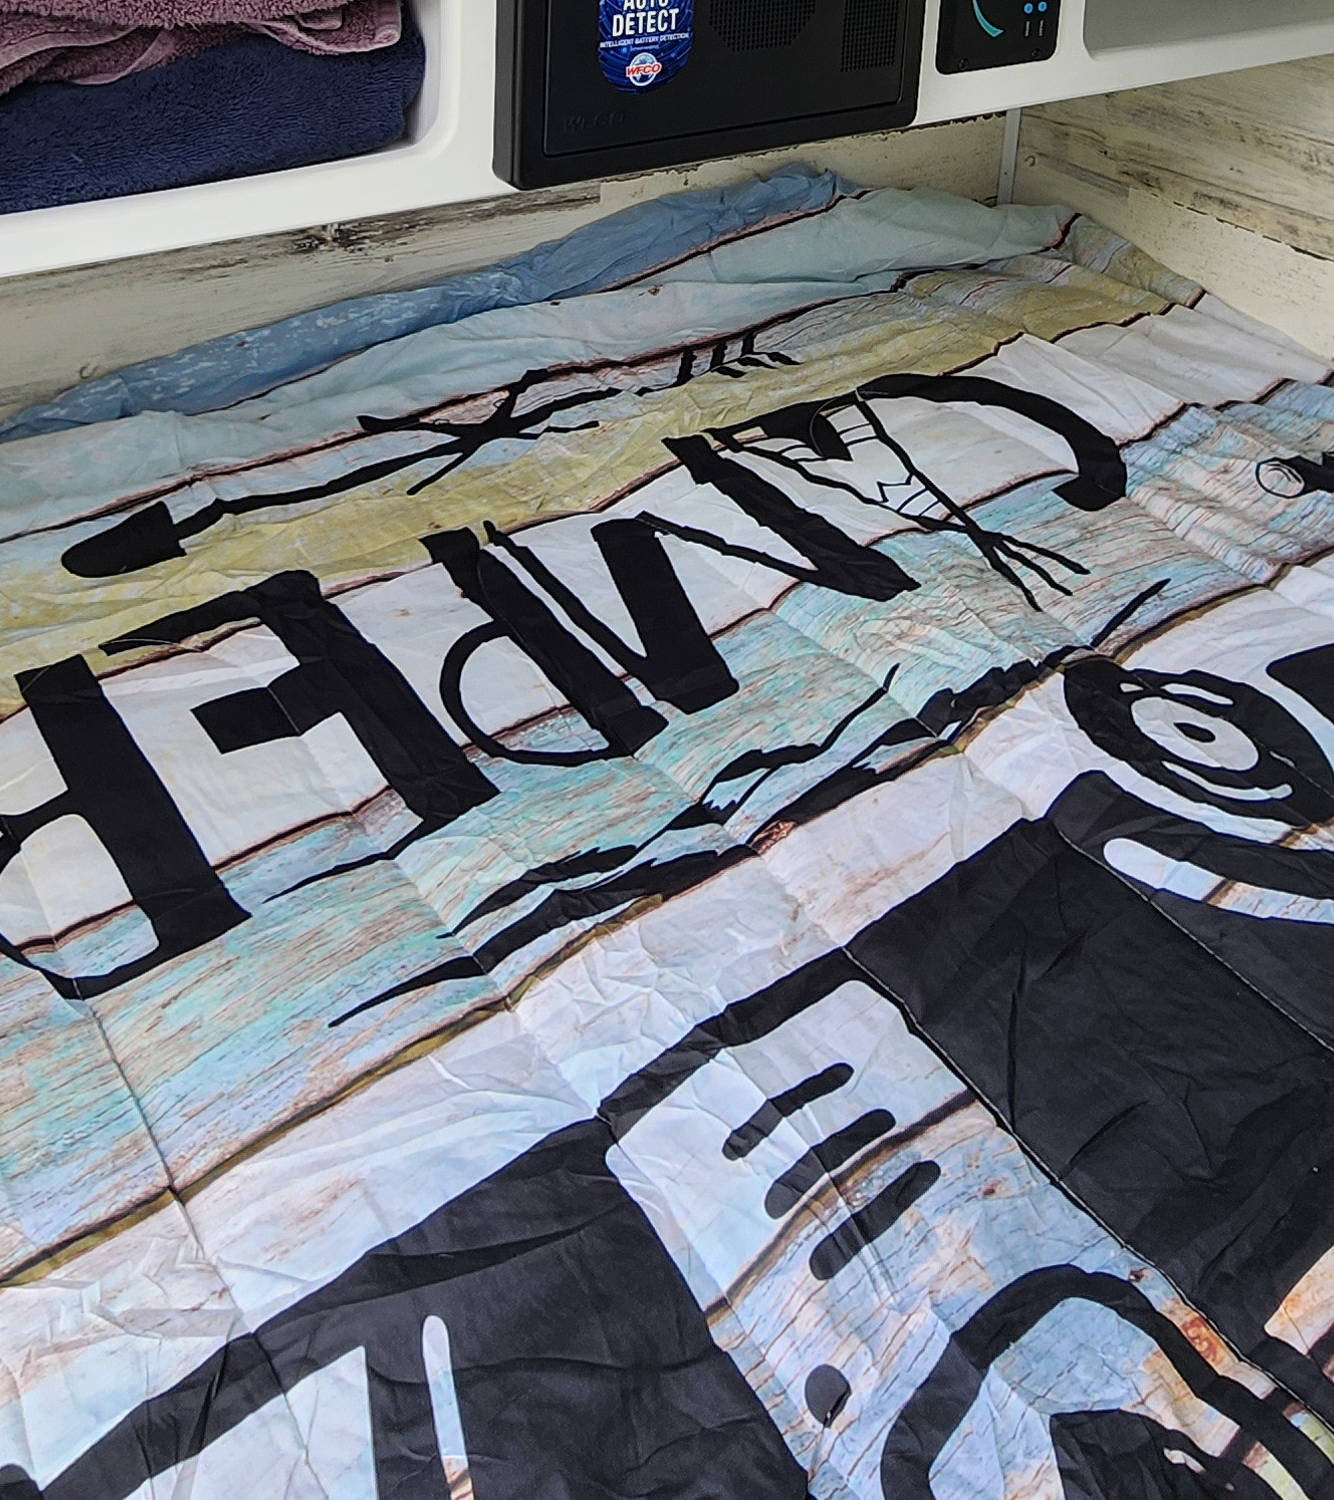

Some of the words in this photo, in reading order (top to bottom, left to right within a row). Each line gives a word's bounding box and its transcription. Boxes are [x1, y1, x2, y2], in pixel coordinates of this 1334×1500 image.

[612, 8, 680, 37] DETECT
[599, 37, 635, 48] INTELLIGENT
[634, 35, 660, 45] BATTERY
[659, 32, 690, 42] DETECTION
[626, 63, 661, 76] WFCO
